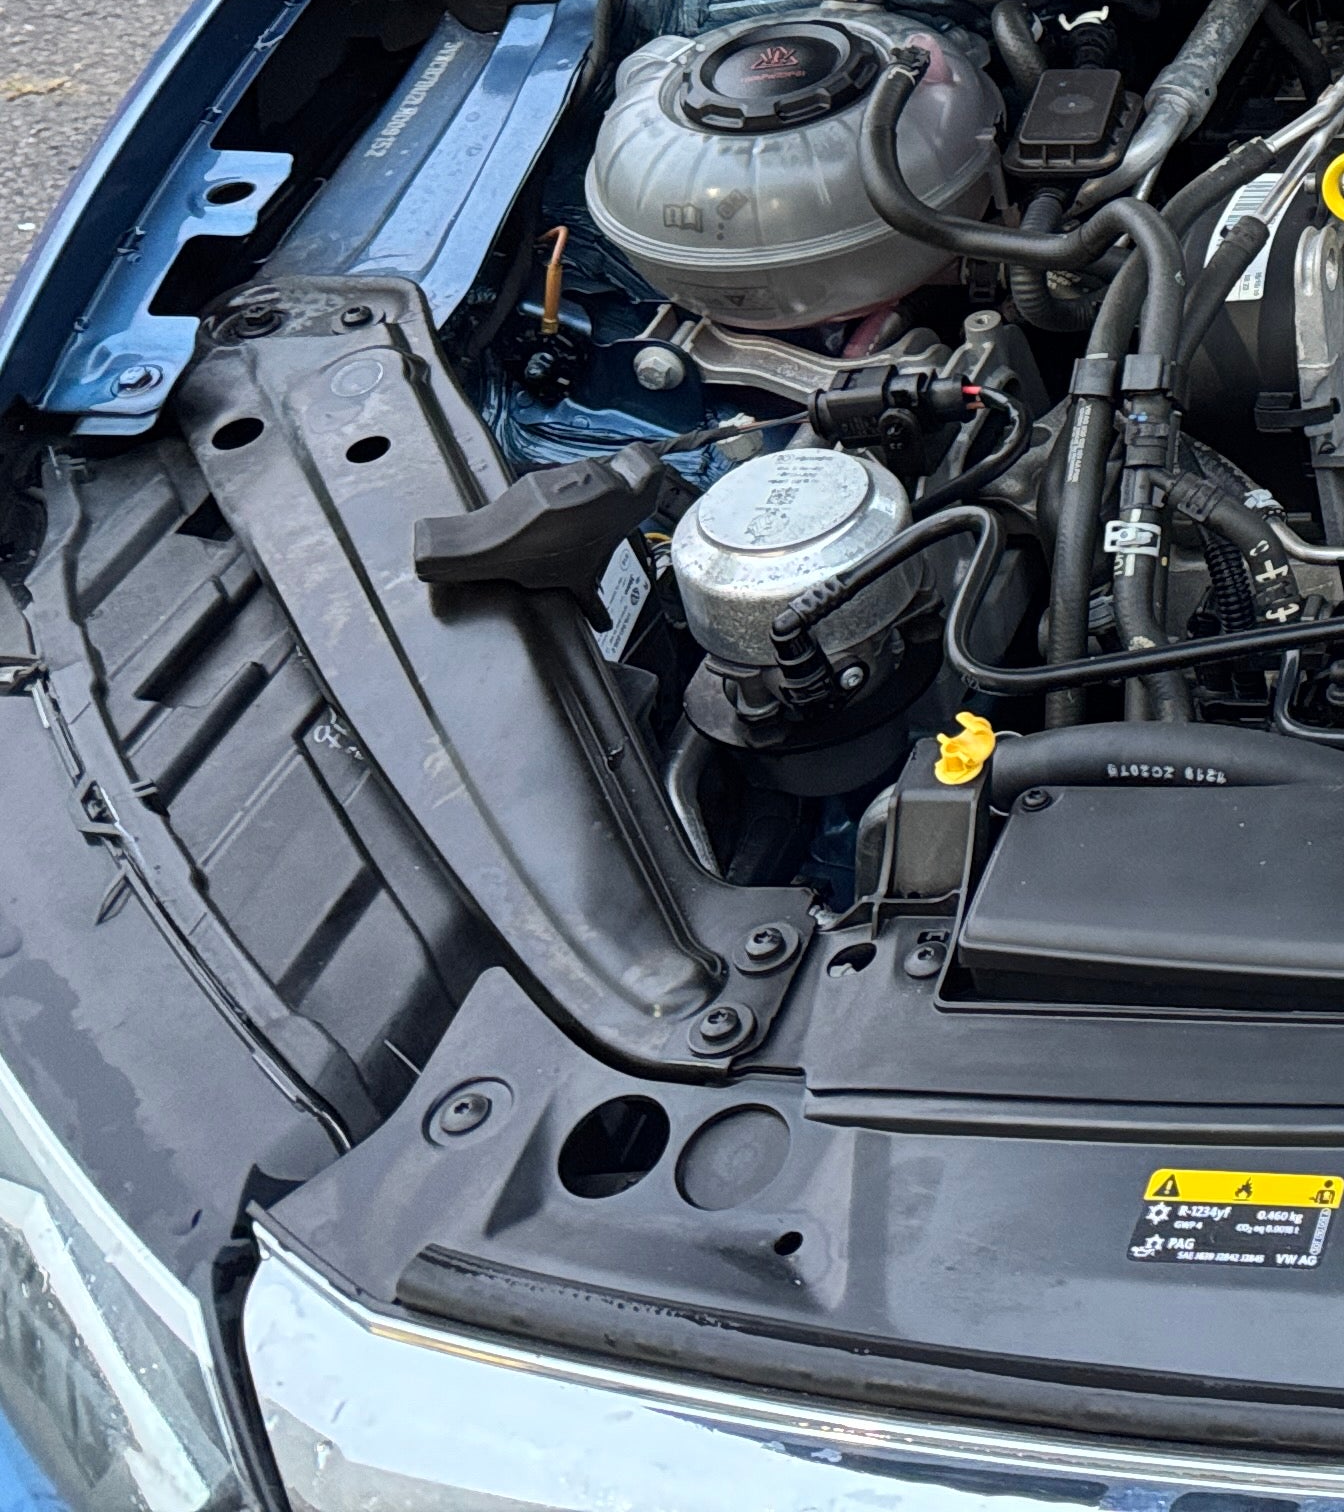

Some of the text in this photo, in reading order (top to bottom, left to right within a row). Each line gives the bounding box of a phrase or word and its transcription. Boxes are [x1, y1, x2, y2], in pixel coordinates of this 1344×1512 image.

[1178, 1206, 1304, 1224] R-1234yf 0.460 kg
[1167, 1238, 1195, 1249] PAG
[1276, 1253, 1295, 1264] VW
[1297, 1254, 1318, 1265] AG
